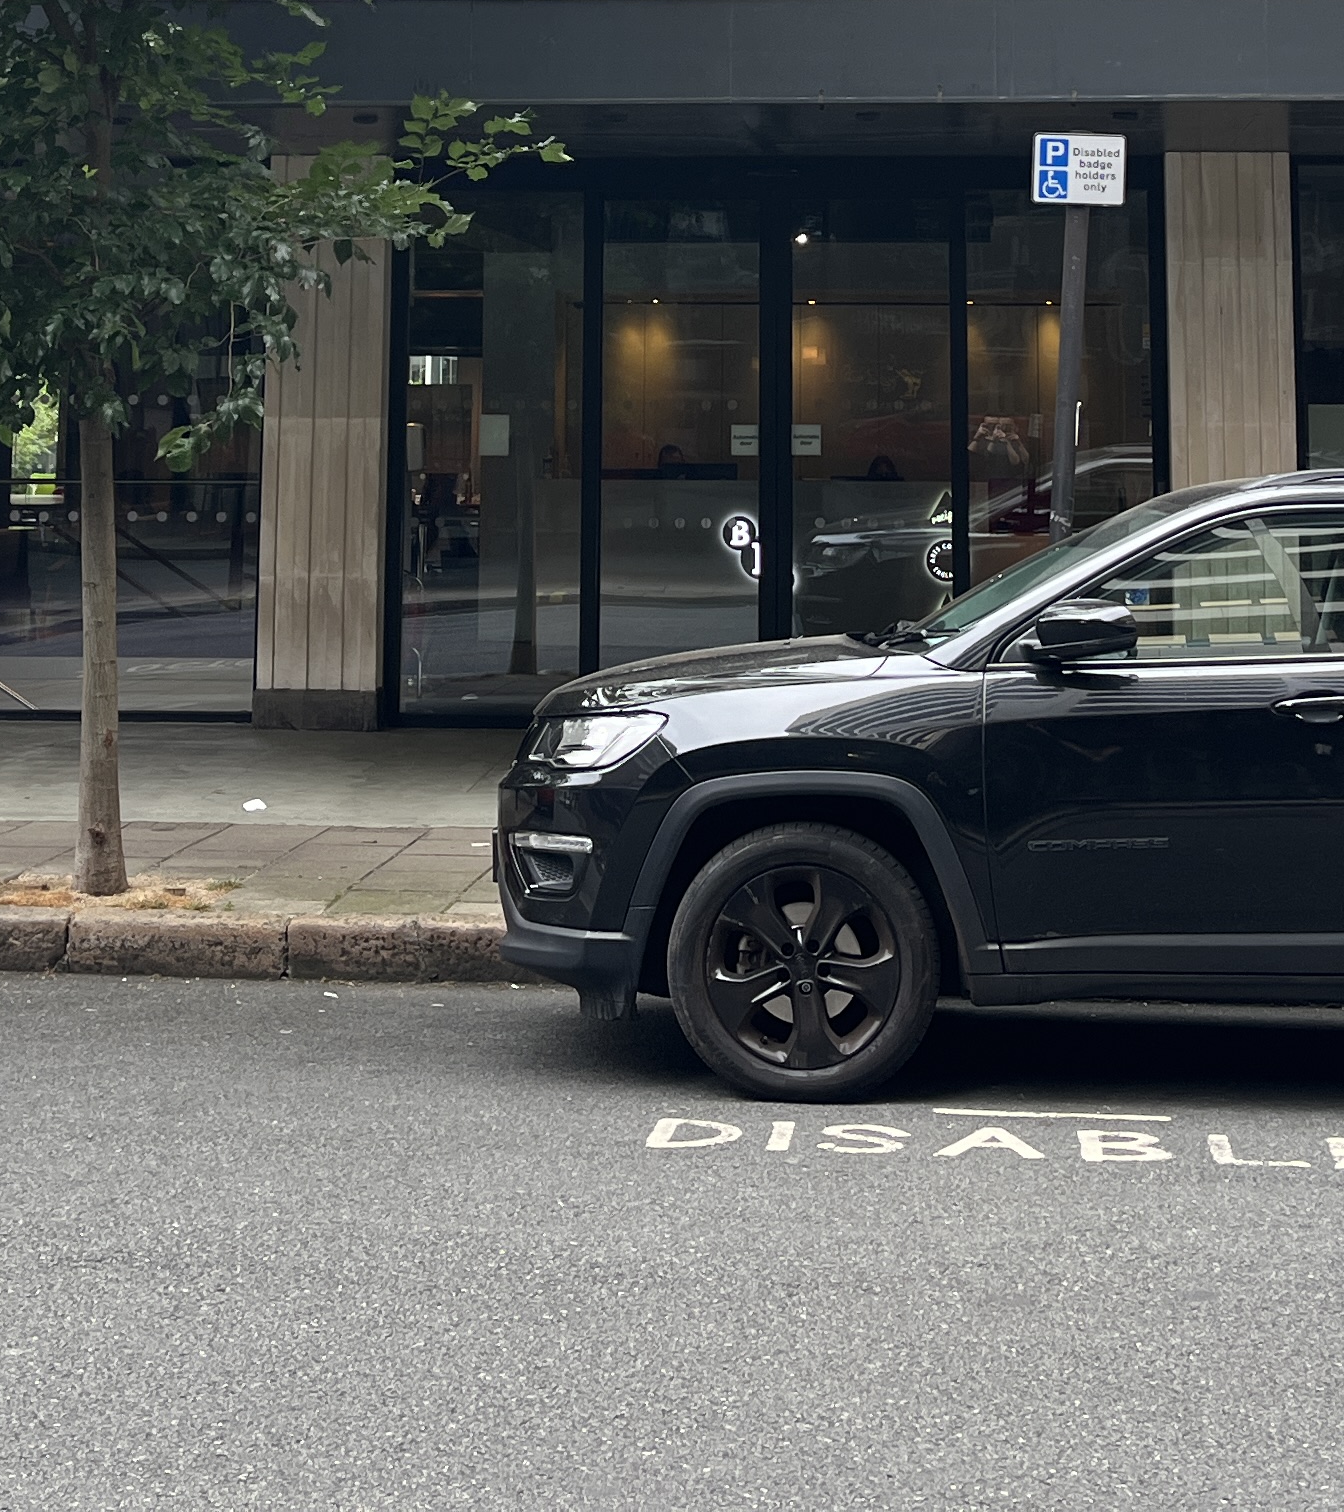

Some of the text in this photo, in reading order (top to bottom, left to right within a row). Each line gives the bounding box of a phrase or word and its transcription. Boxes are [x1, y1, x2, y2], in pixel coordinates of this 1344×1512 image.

[1046, 141, 1065, 165] P
[1072, 147, 1121, 158] Disabled
[1079, 159, 1113, 170] badge
[1075, 170, 1117, 181] holders
[1083, 183, 1107, 193] only
[1027, 837, 1170, 852] COMPASS
